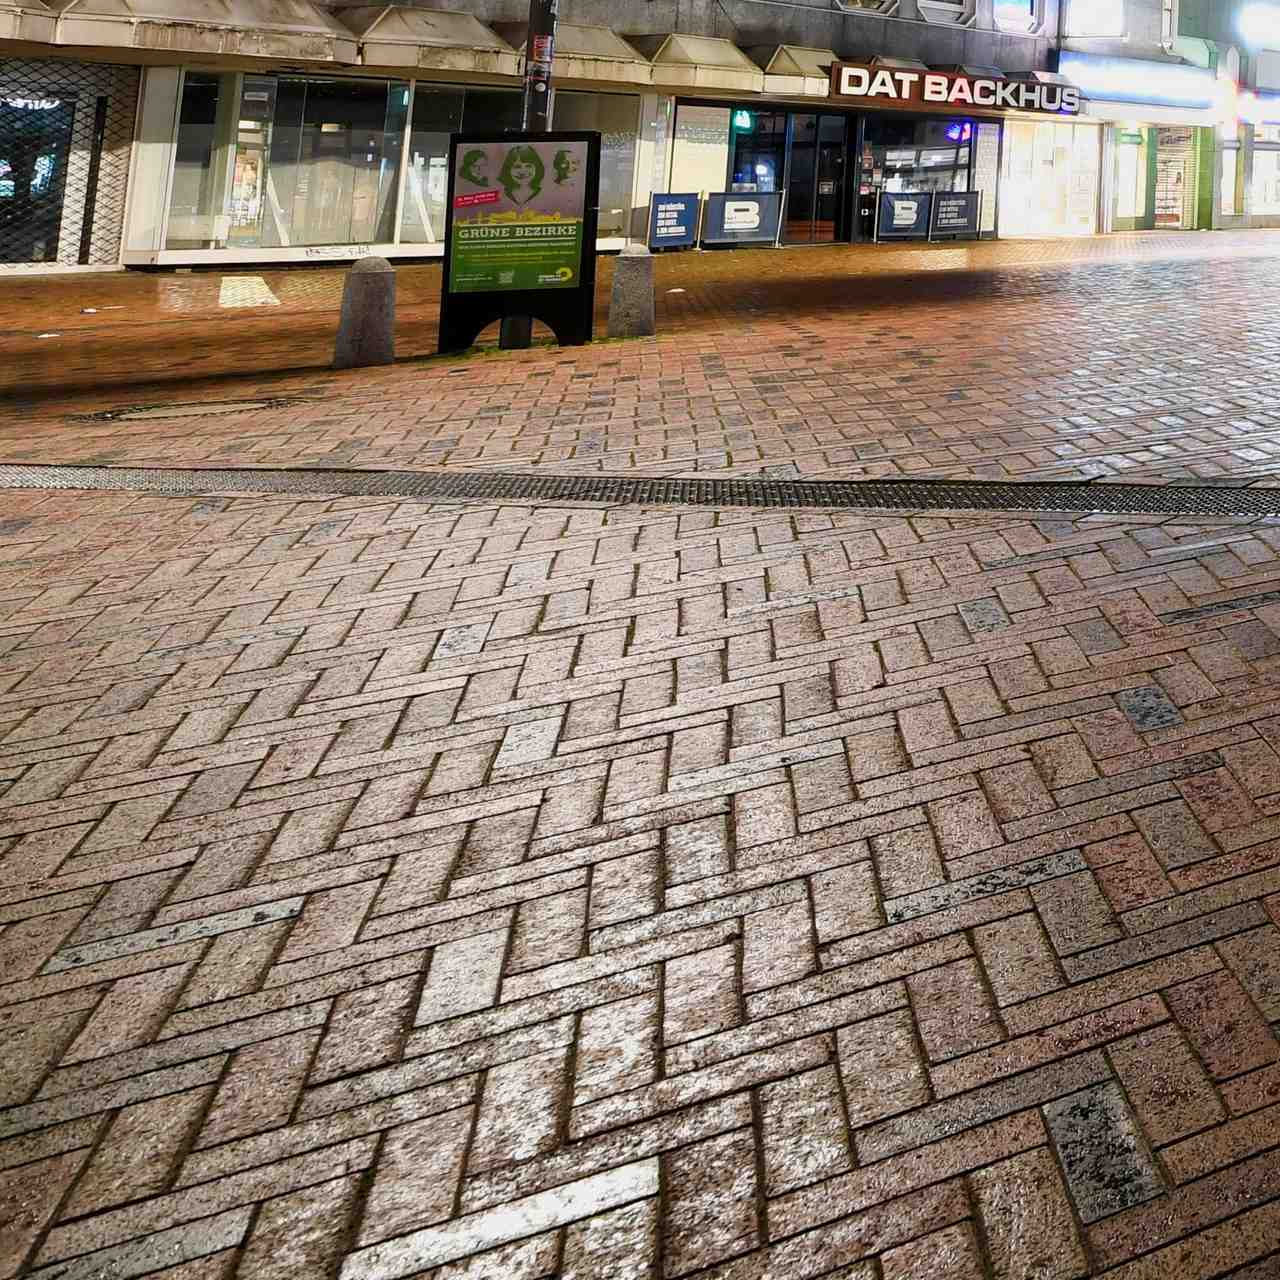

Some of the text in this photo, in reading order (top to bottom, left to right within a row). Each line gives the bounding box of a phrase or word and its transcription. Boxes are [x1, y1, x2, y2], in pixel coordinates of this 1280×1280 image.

[840, 66, 1080, 112] DAT BACKHUS
[459, 225, 577, 239] GRÜNE BEZIRKE
